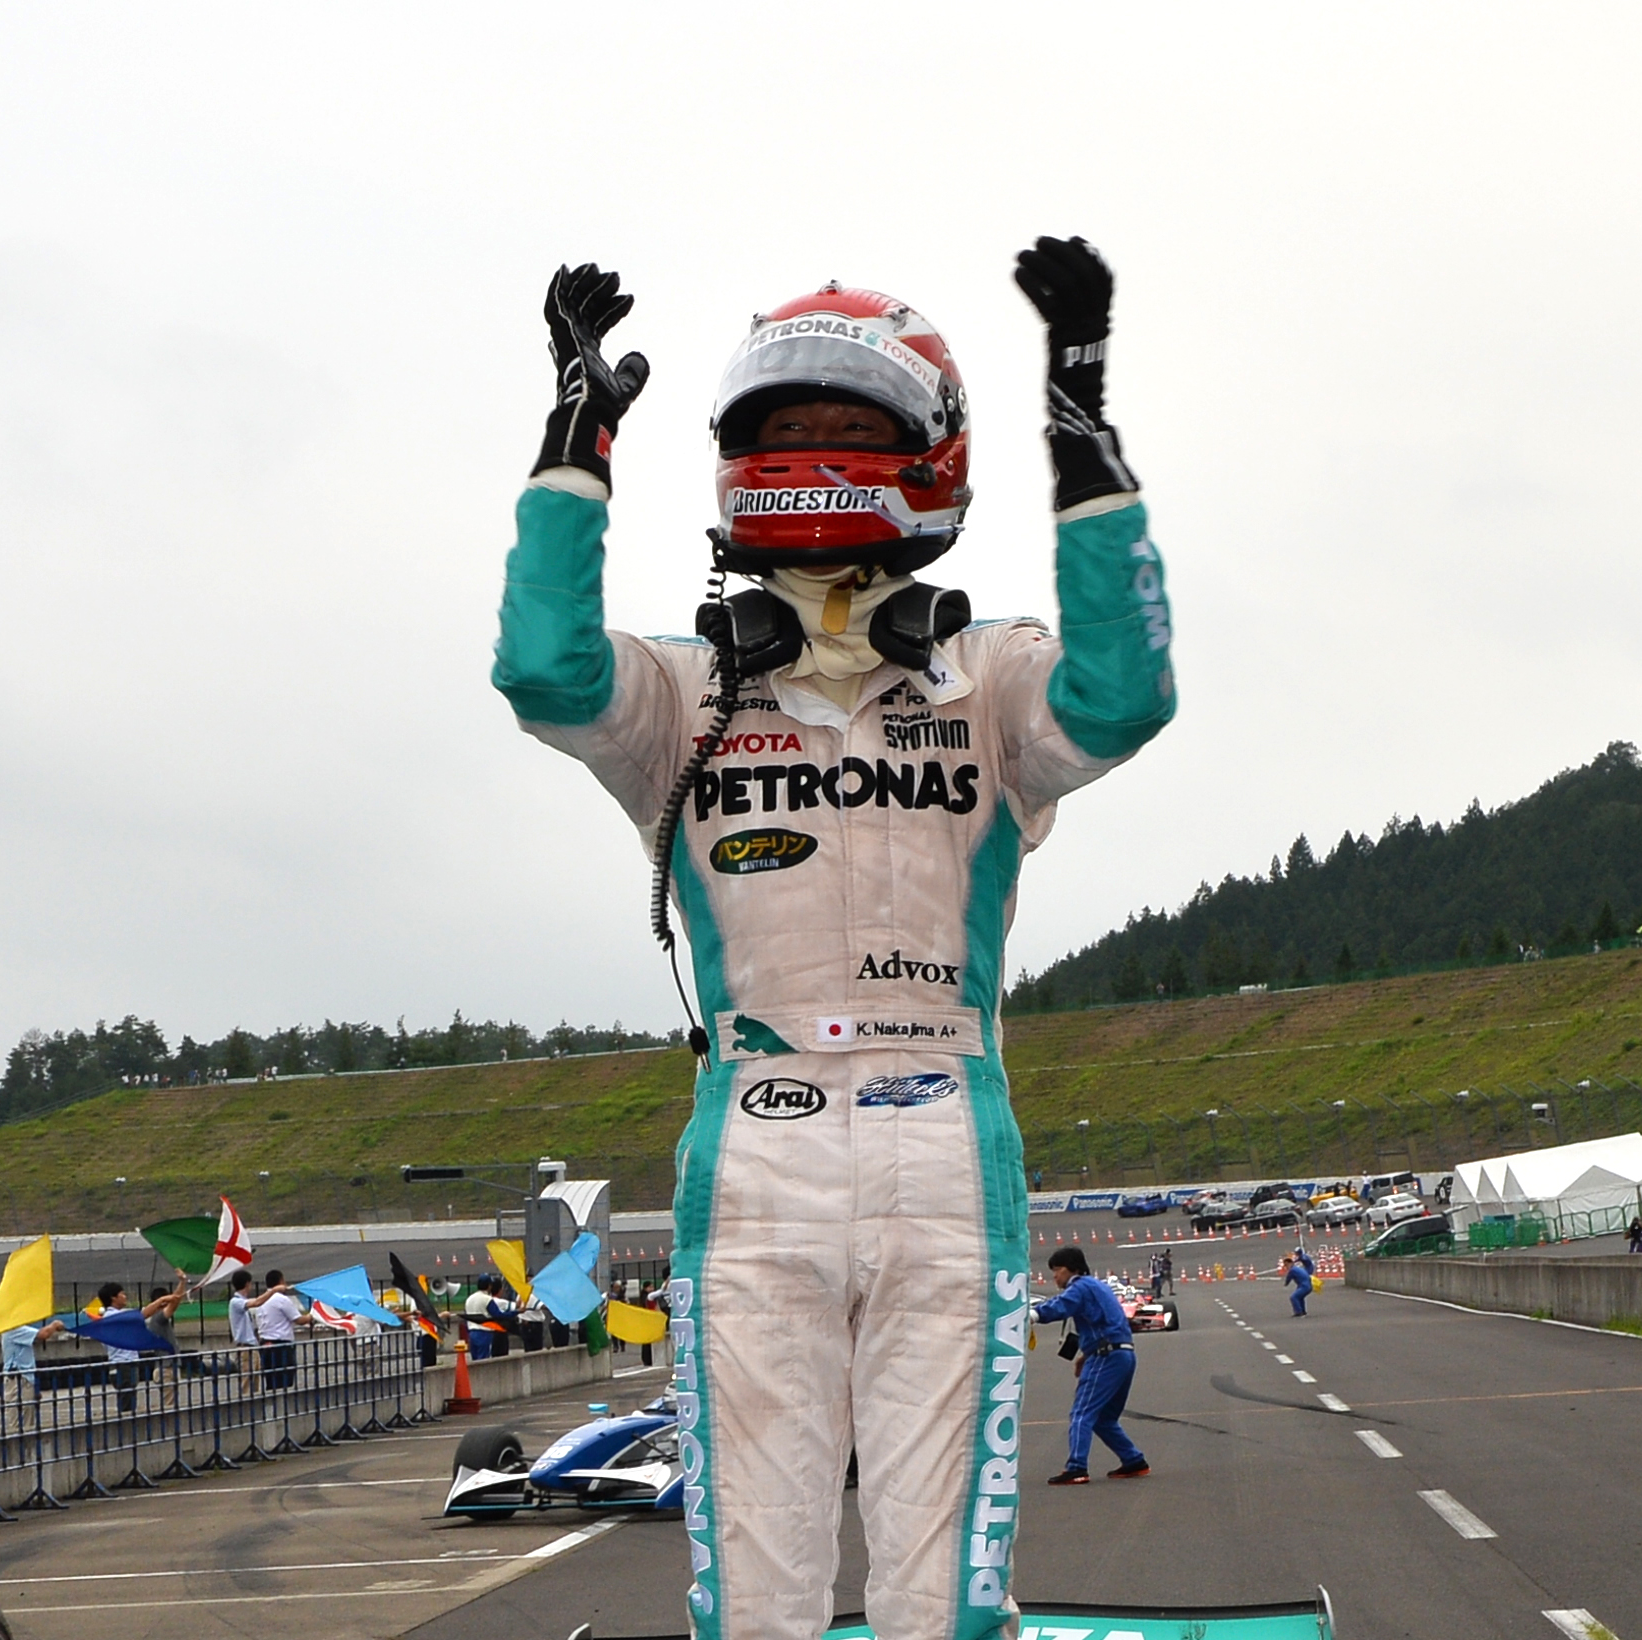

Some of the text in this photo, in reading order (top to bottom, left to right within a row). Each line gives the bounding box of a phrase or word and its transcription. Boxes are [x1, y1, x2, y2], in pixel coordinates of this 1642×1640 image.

[748, 320, 862, 351] PETRONAS
[881, 338, 936, 393] TOYOTA
[733, 485, 884, 516] BRIDGESTONE
[692, 733, 803, 757] TOYOTA
[694, 756, 979, 821] PETRONAS
[857, 949, 959, 985] Advox
[874, 1022, 935, 1039] Nakajima
[940, 1025, 957, 1038] A+
[745, 1083, 817, 1109] Arai
[1072, 1195, 1114, 1210] Panasonic
[668, 1278, 714, 1615] PETRONAS
[967, 1269, 1029, 1607] PETRONAS
